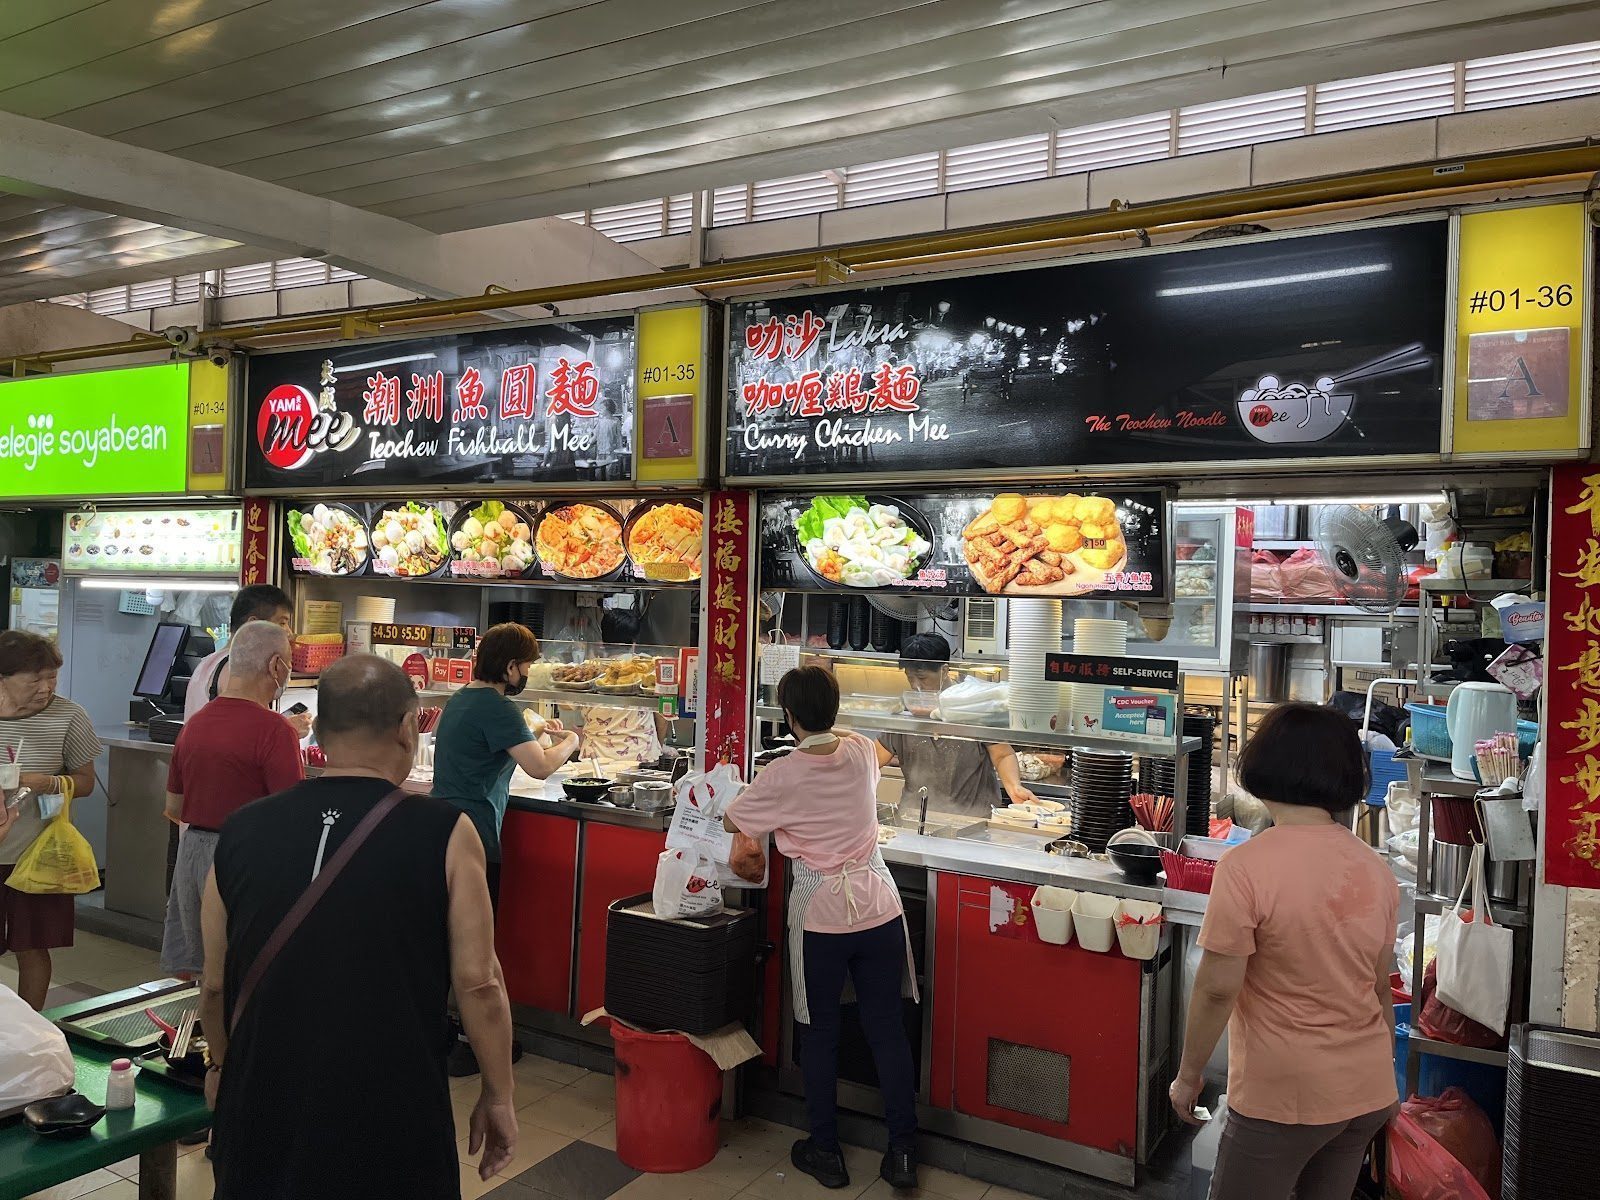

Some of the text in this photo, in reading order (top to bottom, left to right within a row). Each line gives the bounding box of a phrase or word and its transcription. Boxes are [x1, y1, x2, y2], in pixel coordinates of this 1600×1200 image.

[1469, 284, 1573, 313] #01-36
[745, 309, 825, 361] 叻沙
[828, 314, 909, 352] Laksa
[643, 364, 695, 383] #01-35
[1497, 356, 1544, 398] A
[193, 401, 225, 416] #01-34
[1085, 410, 1227, 433] The Teochew Noodle
[59, 412, 167, 468] soyabean
[369, 423, 592, 459] Teochew Fishball Mee
[656, 413, 680, 444] A
[744, 413, 950, 459] Curry Chicken Mee
[373, 625, 398, 640] $4.50
[401, 627, 427, 641] $5.50
[435, 667, 447, 677] Pay
[1112, 667, 1174, 679] SELF-SERVICE
